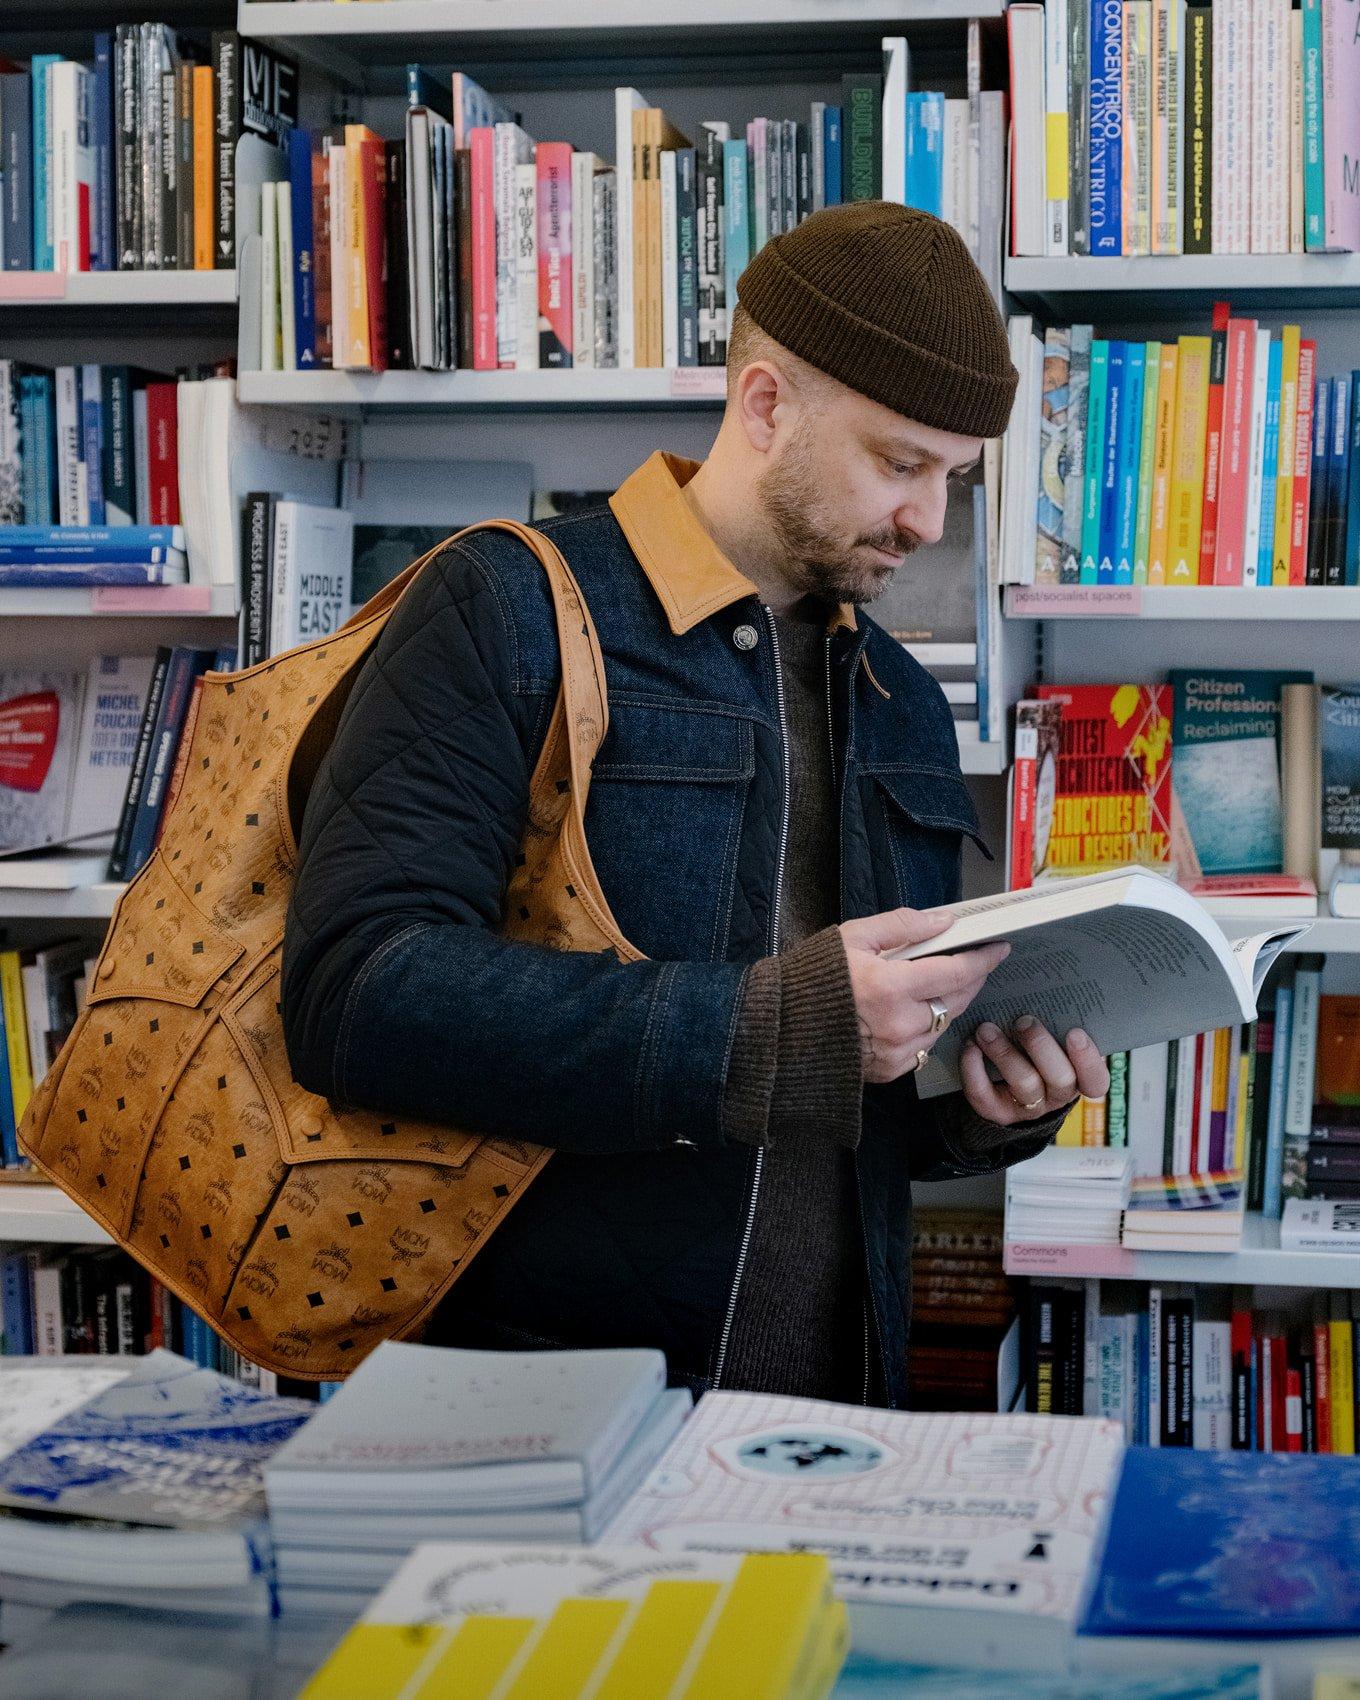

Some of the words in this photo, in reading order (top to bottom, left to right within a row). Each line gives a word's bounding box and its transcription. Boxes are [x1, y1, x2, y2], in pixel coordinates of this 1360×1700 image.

[1308, 104, 1317, 117] the
[1307, 120, 1318, 137] city
[220, 142, 234, 178] Henri
[1108, 386, 1119, 446] Staatssicherheit
[1107, 447, 1116, 460] der
[1106, 462, 1115, 488] Bauten
[251, 501, 265, 561] PROGRESS
[278, 523, 287, 550] EAST
[250, 562, 264, 571] &
[276, 555, 286, 595] MIDDLE
[300, 573, 343, 598] MIDDLE
[1015, 590, 1089, 602] post/socialist
[1092, 591, 1132, 602] spaces
[249, 573, 263, 643] PROSPERITY
[299, 602, 343, 634] EAST
[1185, 679, 1245, 695] Citizen
[96, 694, 140, 710] MICHEL
[93, 713, 141, 729] FOUCAU
[1183, 719, 1277, 737] Reclaiming
[1012, 1245, 1068, 1256] Commons
[1181, 1316, 1190, 1365] Stadtviertel
[1182, 1368, 1190, 1422] Mikrokosmos
